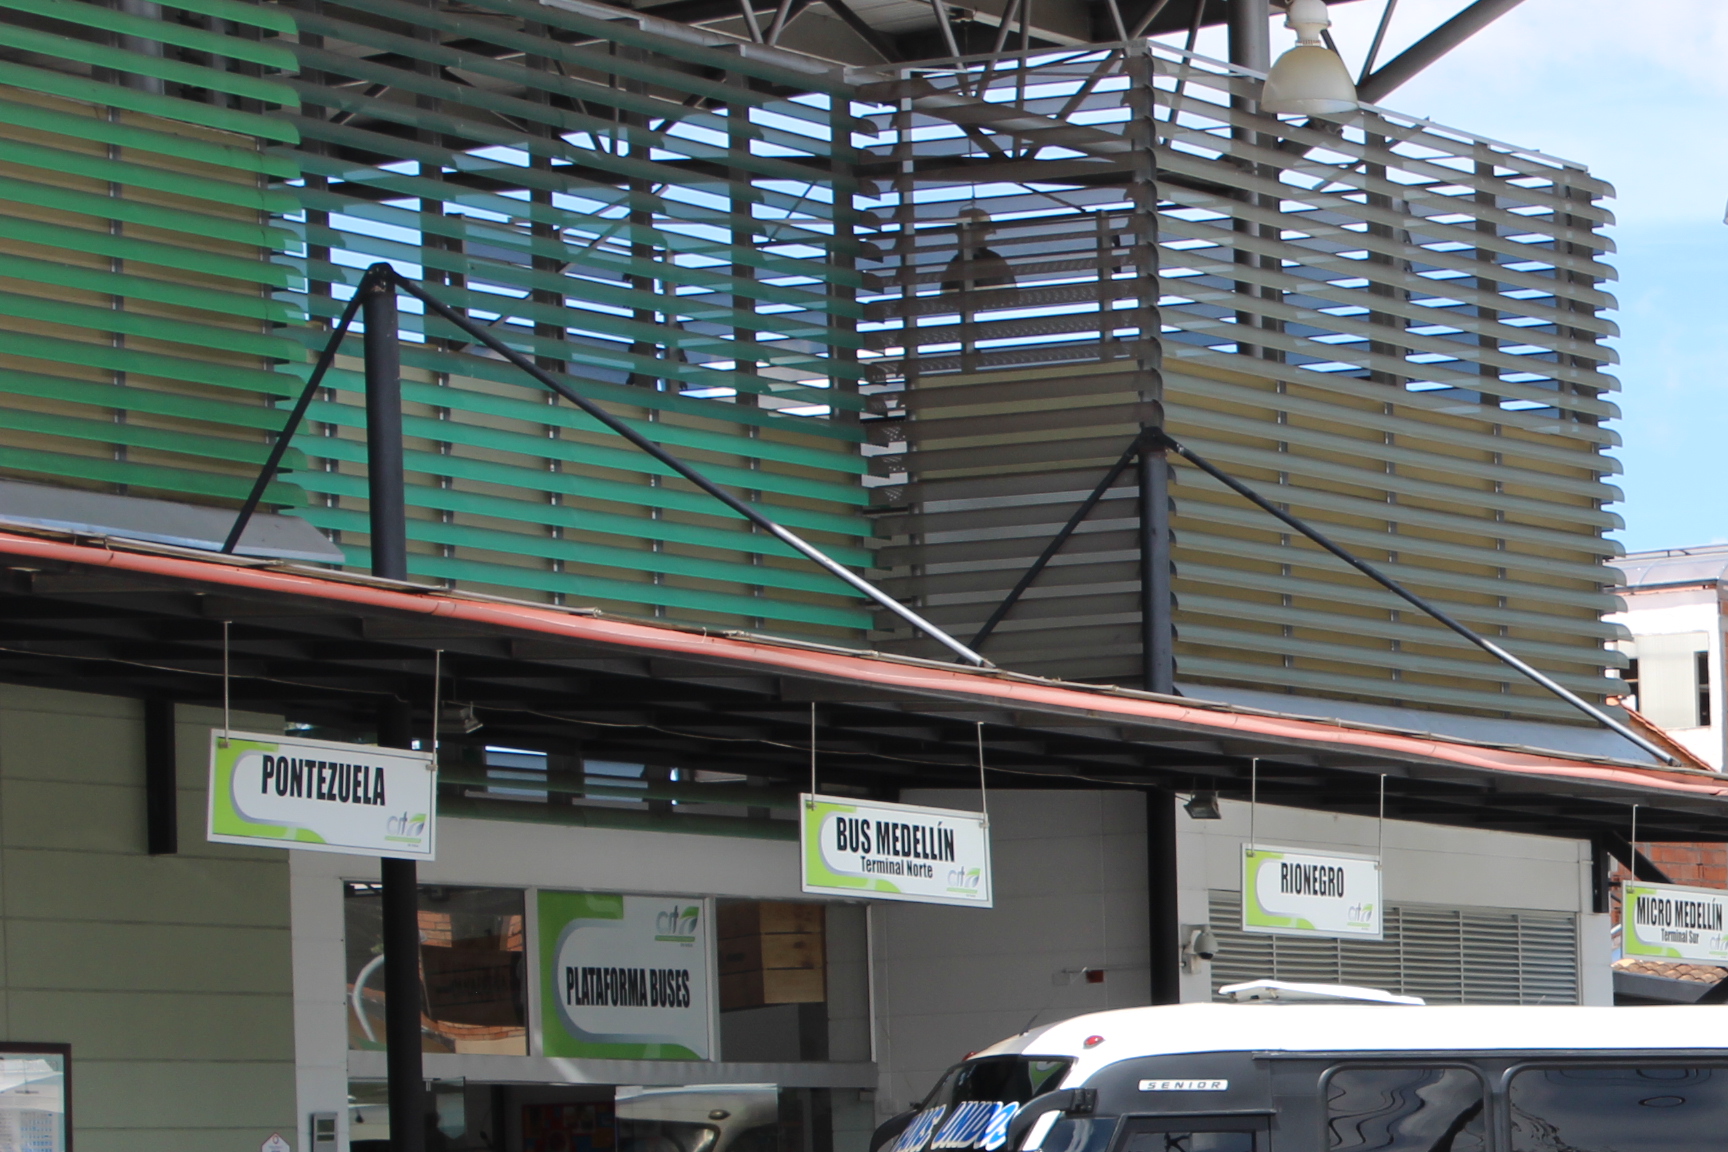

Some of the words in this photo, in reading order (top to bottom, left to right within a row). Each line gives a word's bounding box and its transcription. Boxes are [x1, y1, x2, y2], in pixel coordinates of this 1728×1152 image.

[261, 755, 386, 806] PONTEZUELA
[836, 817, 871, 854] BUS
[876, 821, 955, 862] MEDELLÍN
[860, 855, 905, 876] Terminal
[906, 861, 933, 879] Norte
[1281, 862, 1344, 898] RIONEGRO
[1637, 896, 1672, 927] MICRO
[1675, 898, 1722, 931] MEDELLÍN
[1661, 928, 1688, 943] Terminal
[1689, 930, 1699, 944] Sur
[566, 966, 648, 1007] PLATAFORMA
[650, 968, 691, 1008] BUSES
[1147, 1081, 1222, 1090] SENIOR
